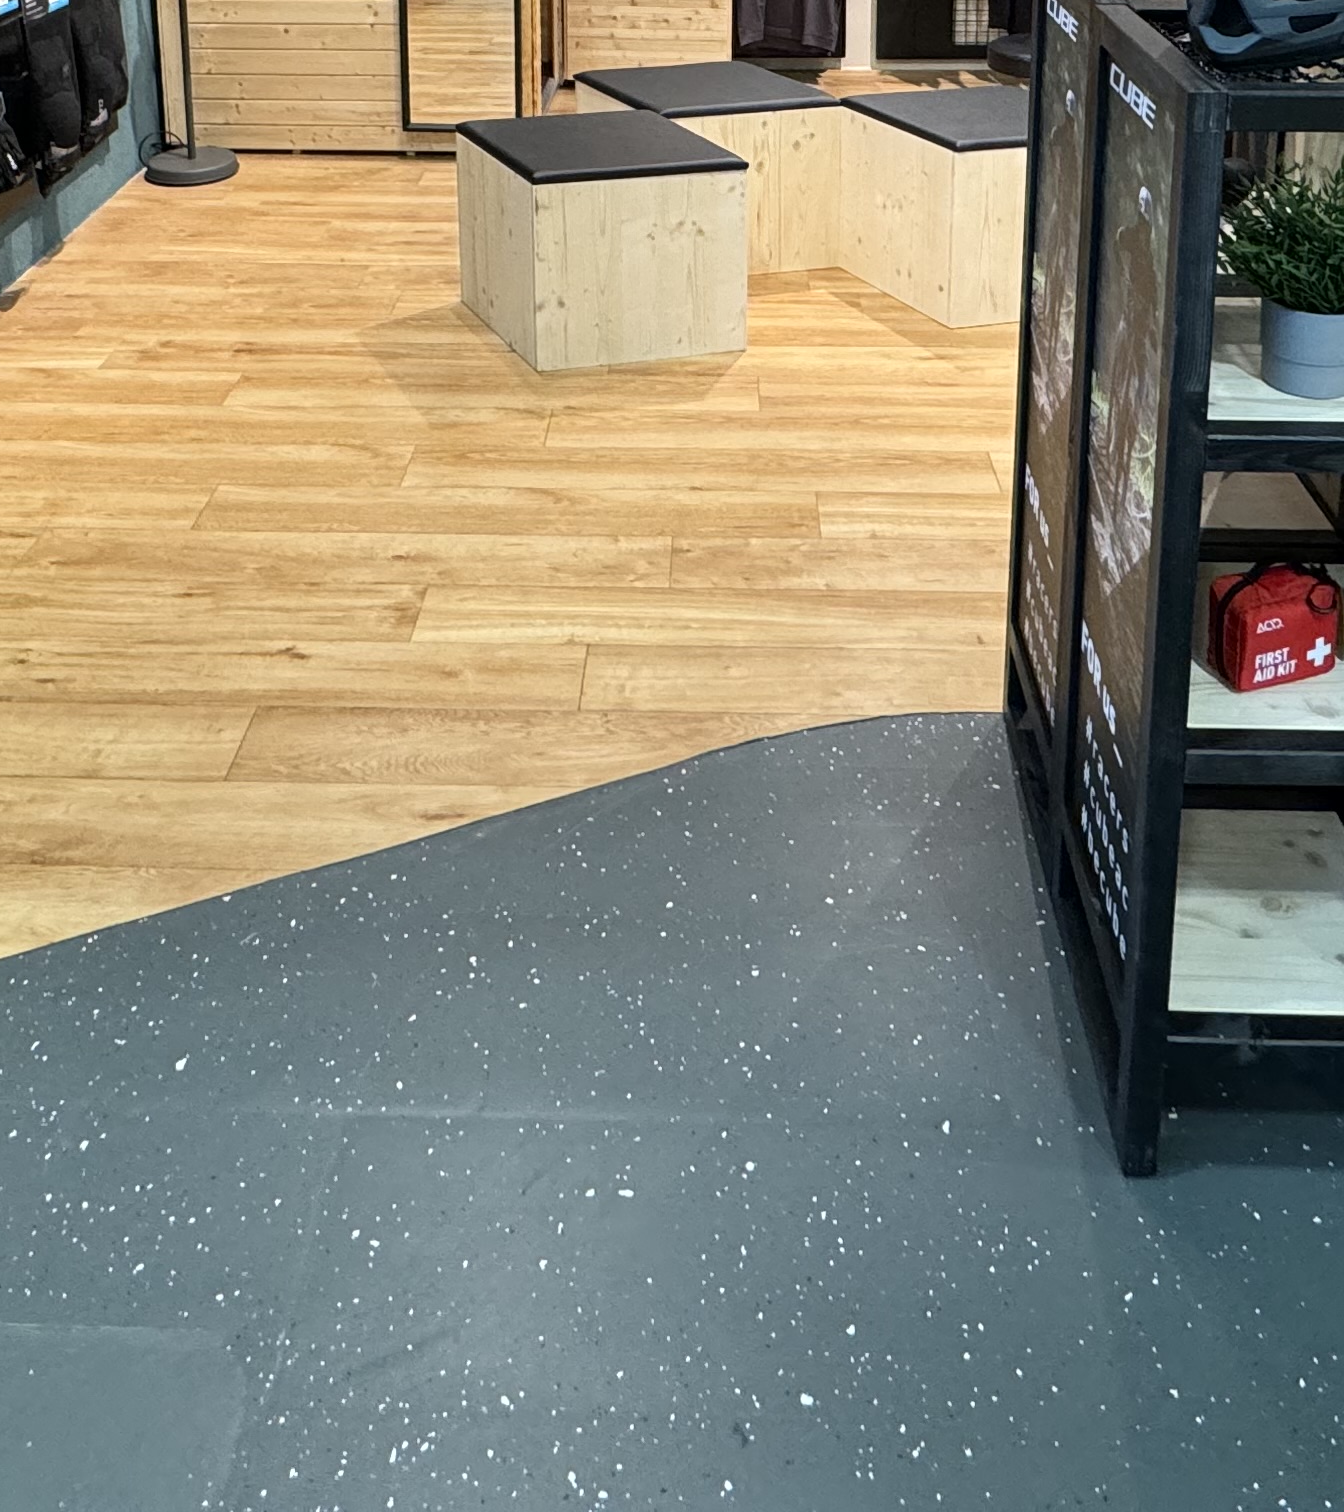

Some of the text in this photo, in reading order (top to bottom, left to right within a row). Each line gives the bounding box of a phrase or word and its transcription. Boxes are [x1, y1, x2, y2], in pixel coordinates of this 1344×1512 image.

[1109, 62, 1157, 130] CUBE
[1024, 462, 1040, 522] FOR
[1027, 540, 1059, 641] #racers
[1081, 618, 1102, 699] FOR
[1102, 684, 1117, 736] US
[1252, 658, 1298, 684] AID KIT
[1255, 646, 1291, 670] FIRST
[1085, 714, 1129, 855] #racers
[1080, 803, 1127, 961] #becube
